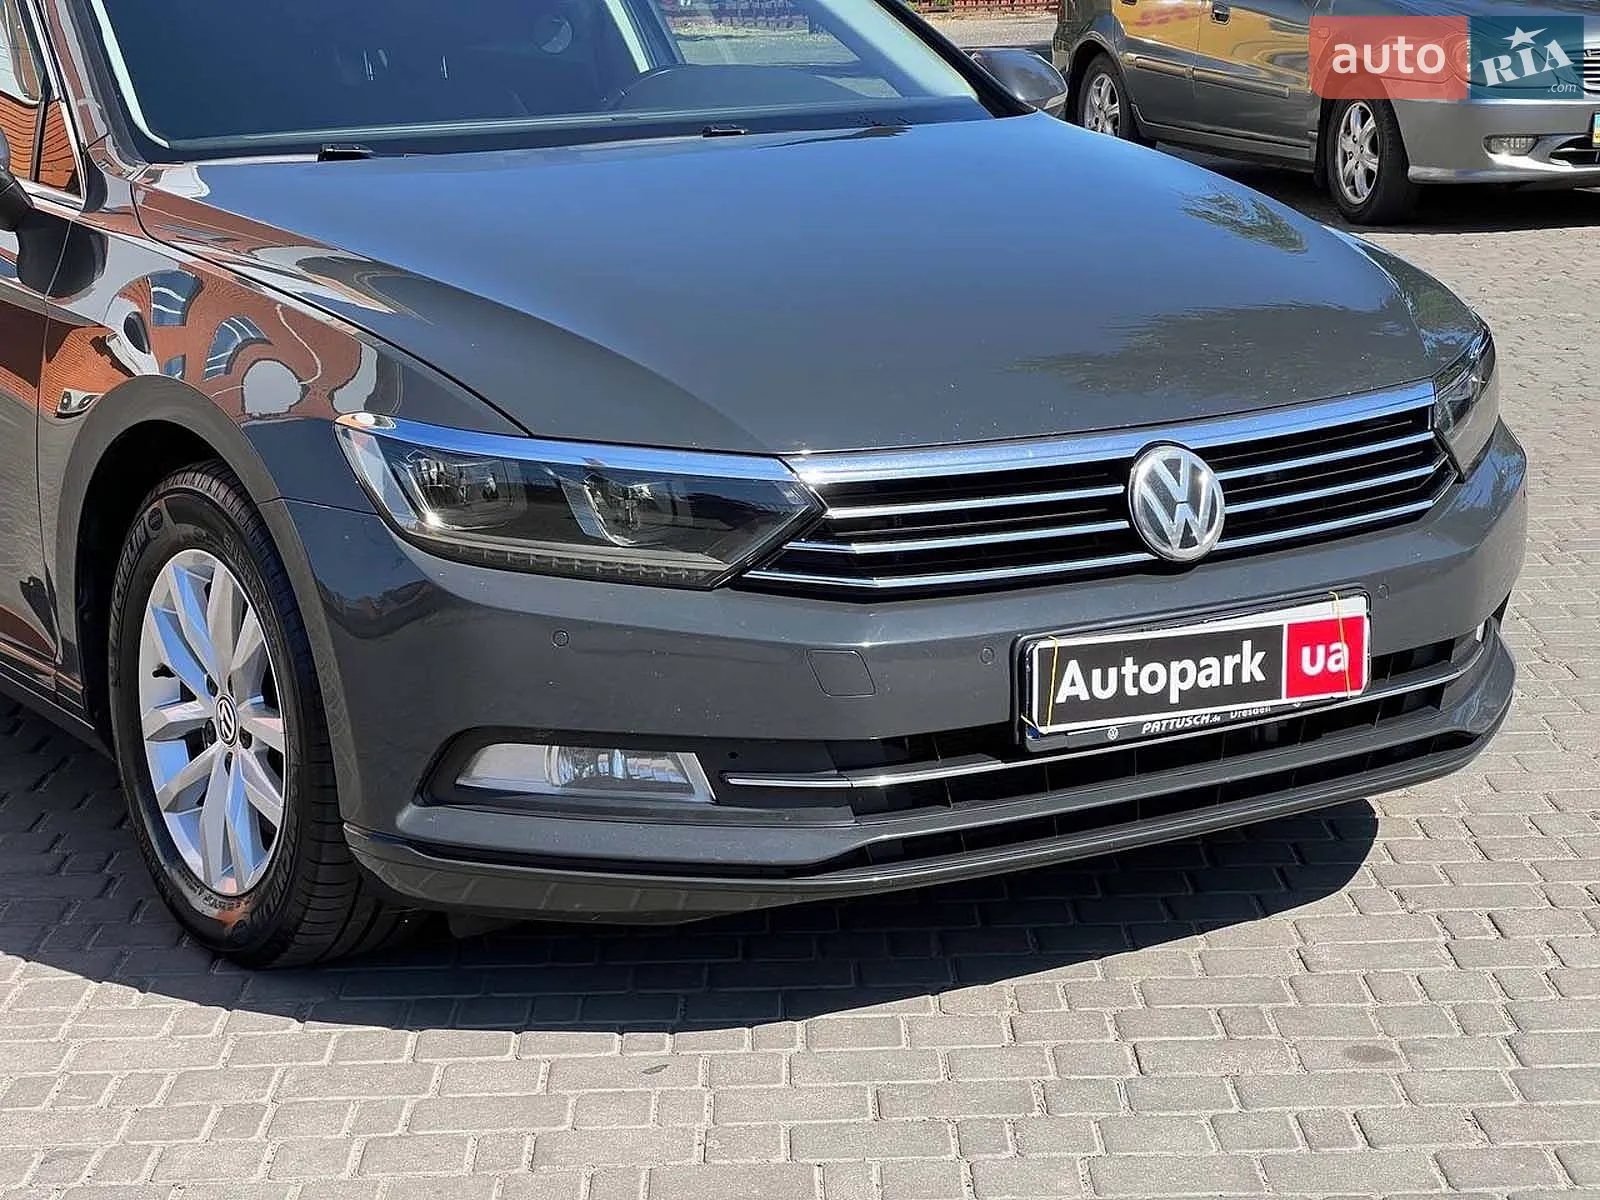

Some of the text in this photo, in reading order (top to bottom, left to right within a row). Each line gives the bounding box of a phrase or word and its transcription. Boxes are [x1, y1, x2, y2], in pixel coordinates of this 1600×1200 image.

[109, 517, 149, 648] MICHELIN
[1056, 640, 1350, 704] Autopark ua
